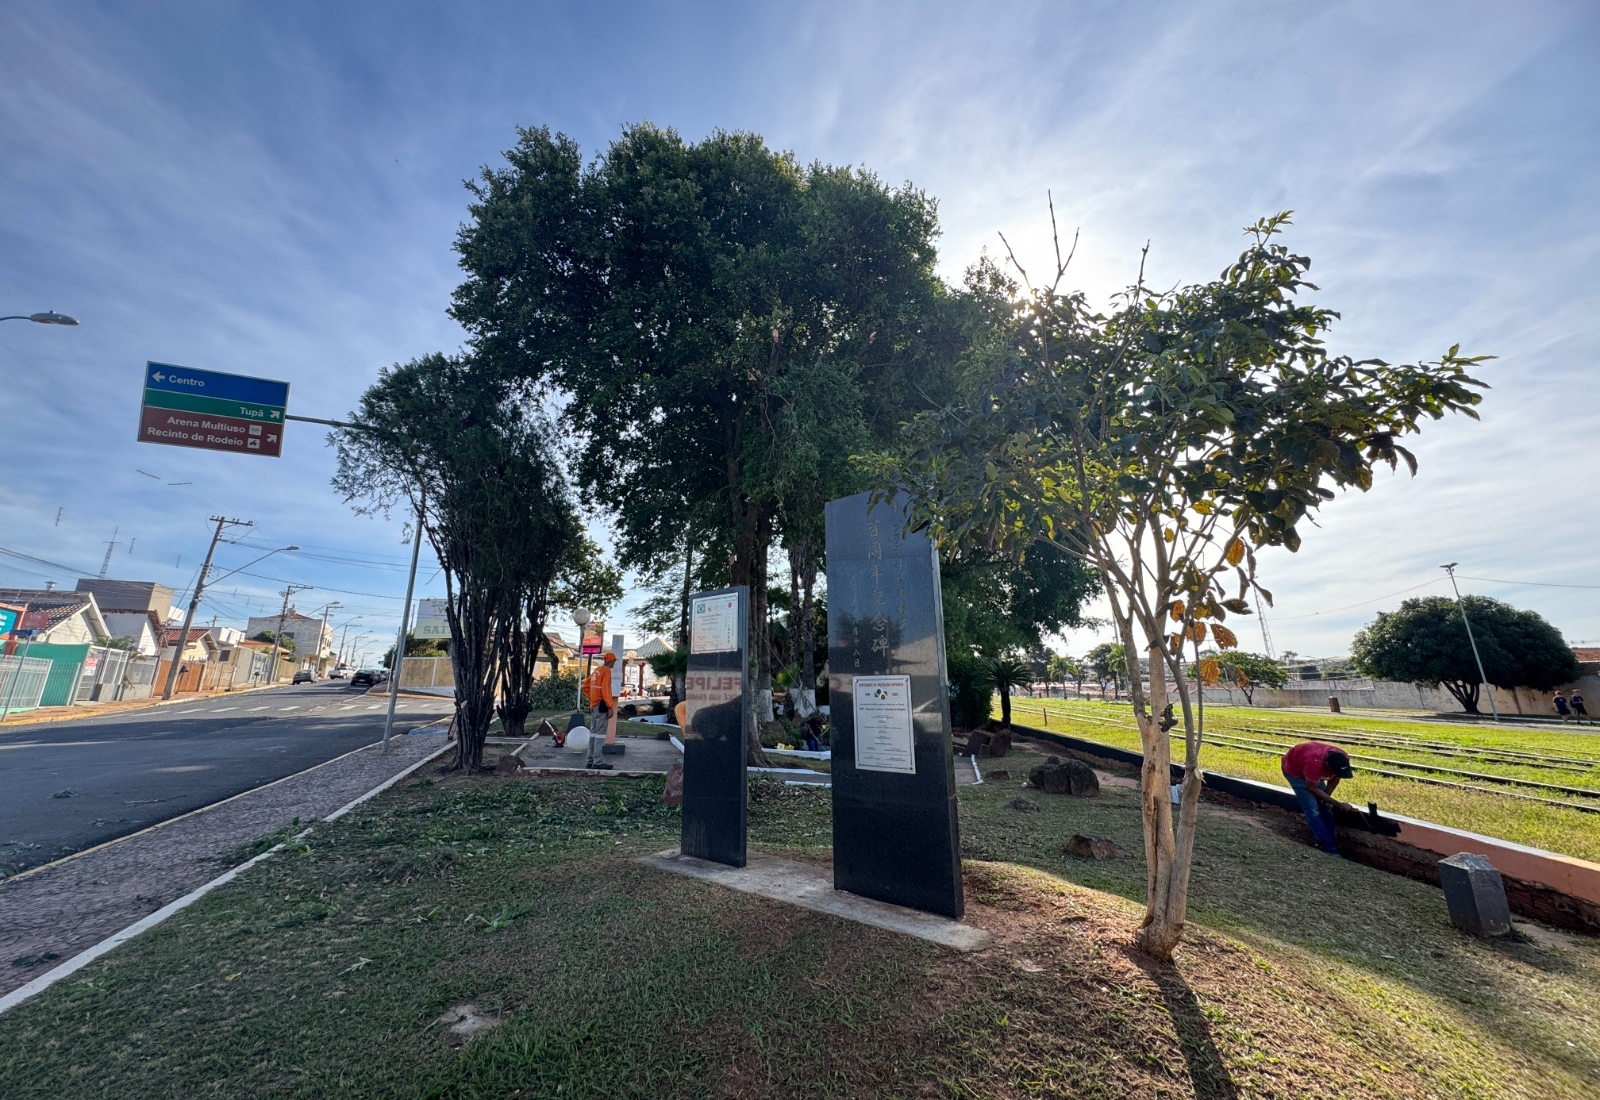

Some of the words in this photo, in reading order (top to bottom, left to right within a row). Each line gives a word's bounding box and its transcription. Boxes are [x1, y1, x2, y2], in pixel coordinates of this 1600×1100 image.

[169, 374, 205, 387] Centro
[166, 416, 199, 428] Arena
[201, 420, 246, 434] Multiuso
[147, 427, 189, 439] Recinto
[191, 433, 205, 442] de
[207, 434, 244, 447] Rodeio
[423, 625, 452, 634] SAT
